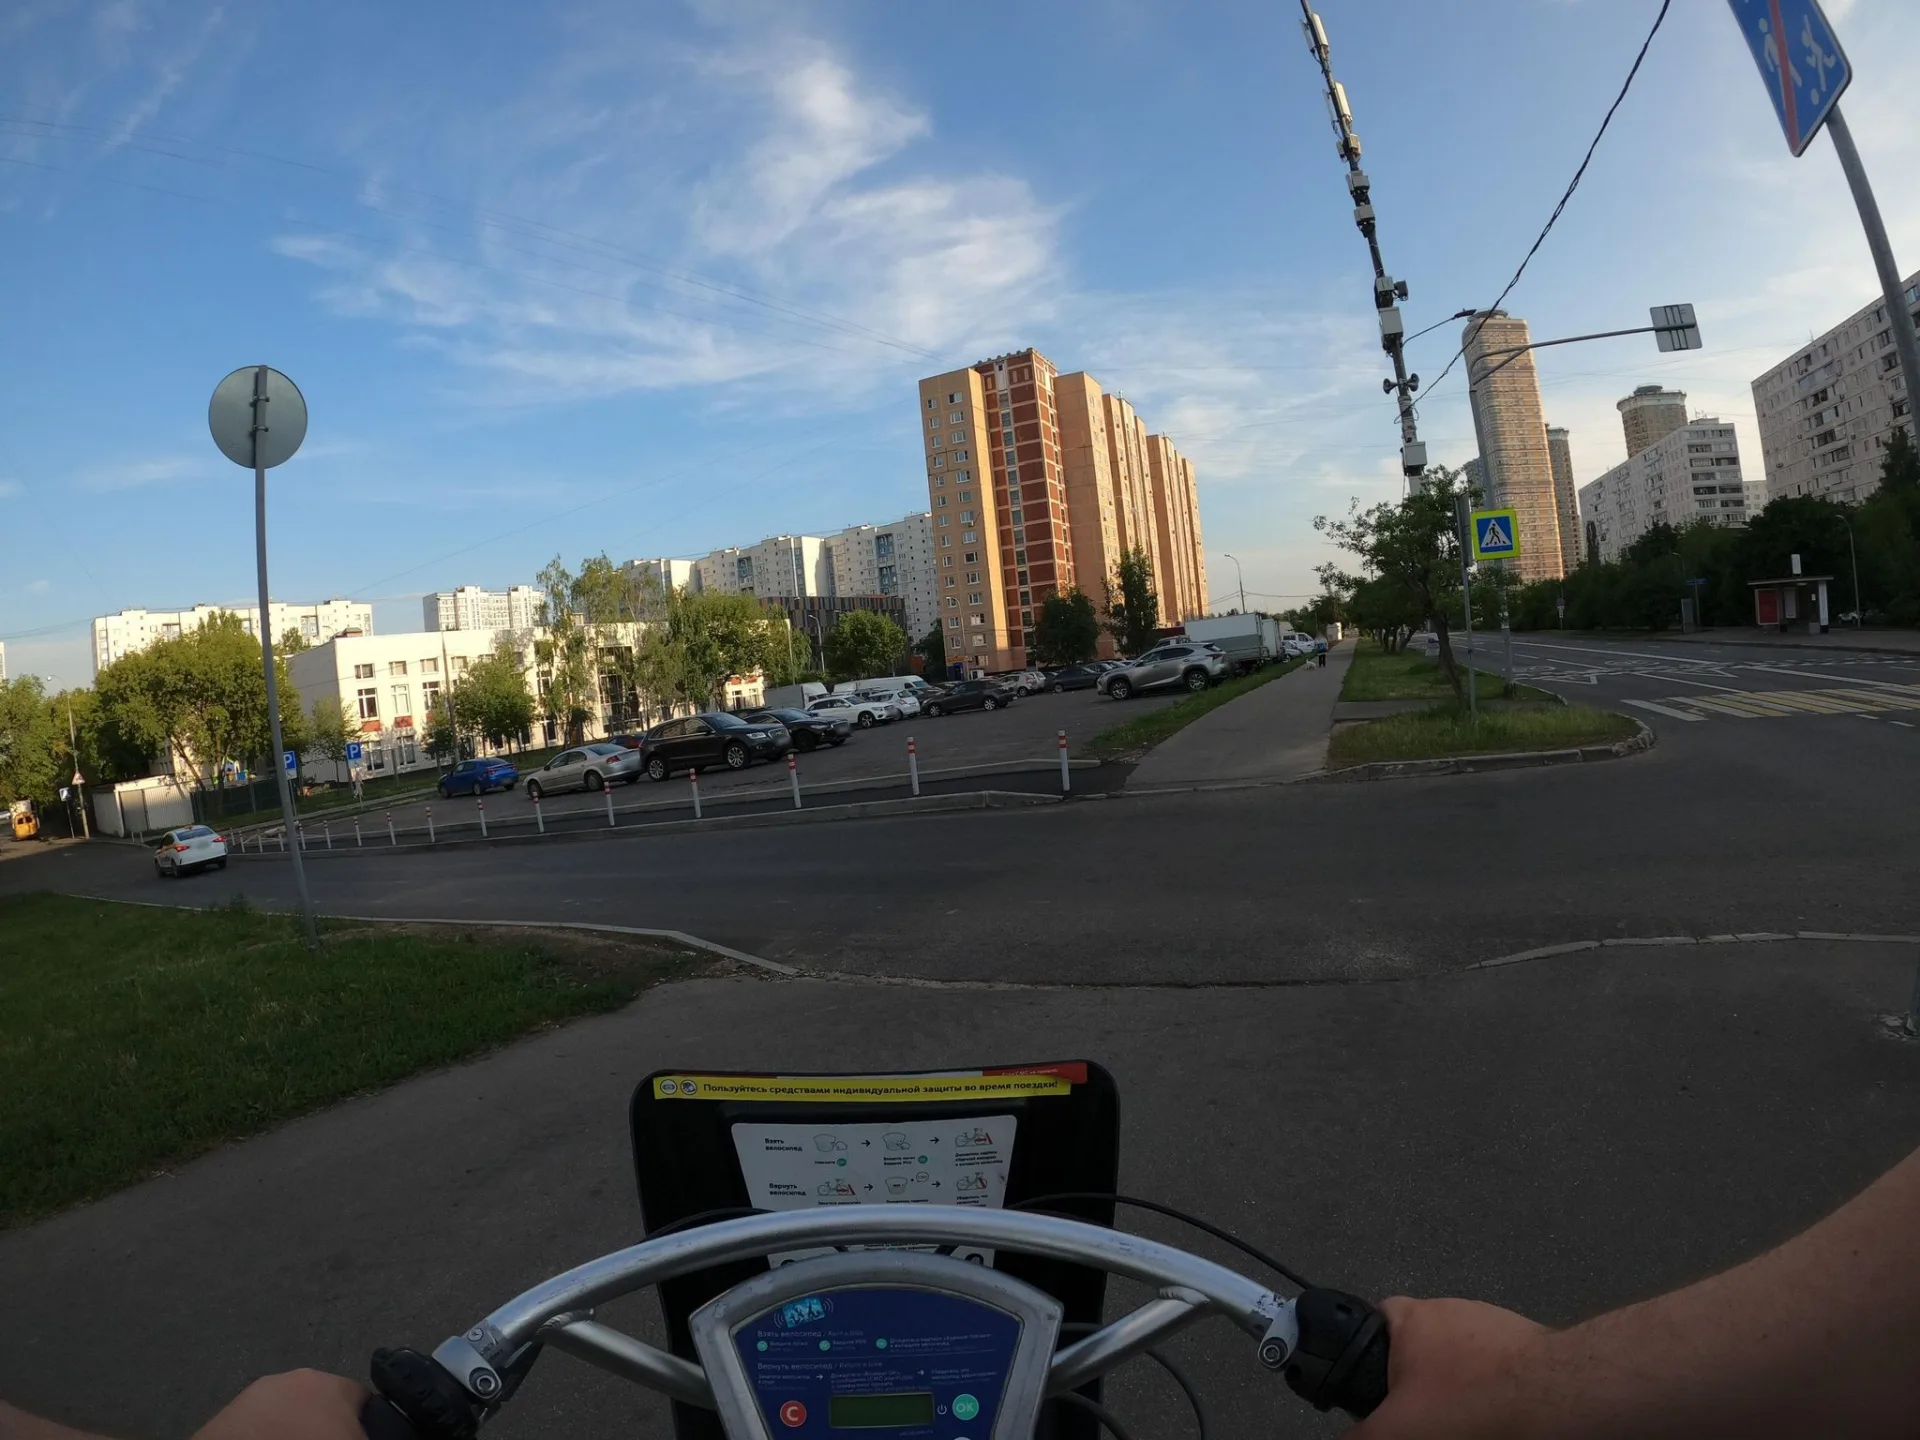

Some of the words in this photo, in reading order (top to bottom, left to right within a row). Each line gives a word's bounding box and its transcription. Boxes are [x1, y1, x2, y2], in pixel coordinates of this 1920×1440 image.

[703, 1083, 768, 1094] Пользуйтесь
[769, 1086, 831, 1096] средствами
[833, 1085, 920, 1096] индивидуальной
[922, 1084, 962, 1094] защиты
[979, 1083, 1012, 1093] время
[1013, 1080, 1059, 1091] поездки!
[757, 1362, 789, 1371] Вернуть
[955, 1402, 975, 1413] OK
